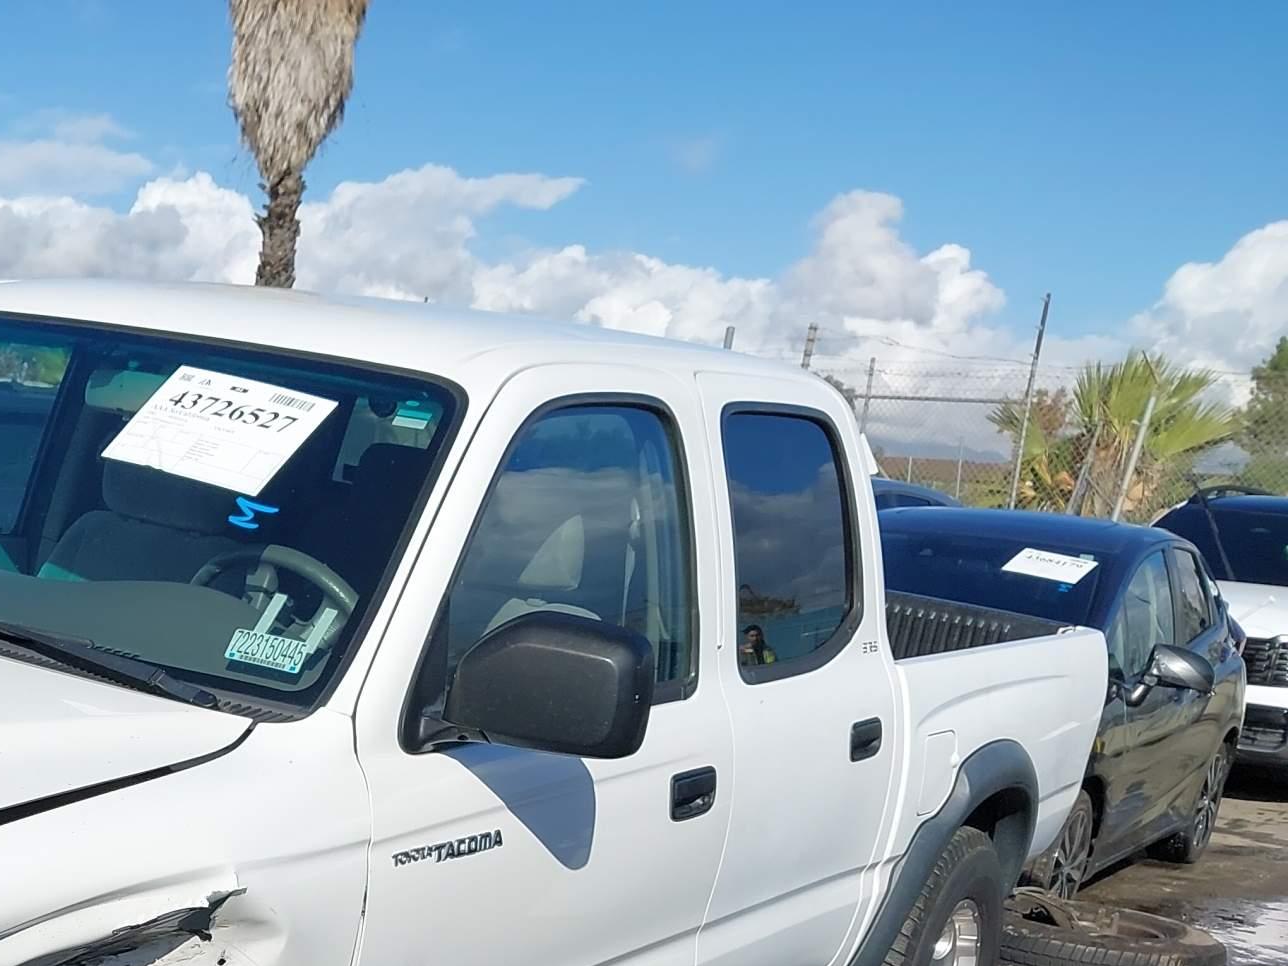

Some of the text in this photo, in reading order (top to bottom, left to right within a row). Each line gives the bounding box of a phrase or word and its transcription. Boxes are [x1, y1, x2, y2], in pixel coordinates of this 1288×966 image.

[169, 391, 299, 432] 43726527
[230, 630, 307, 666] 7223150445
[431, 829, 503, 863] TACOMA
